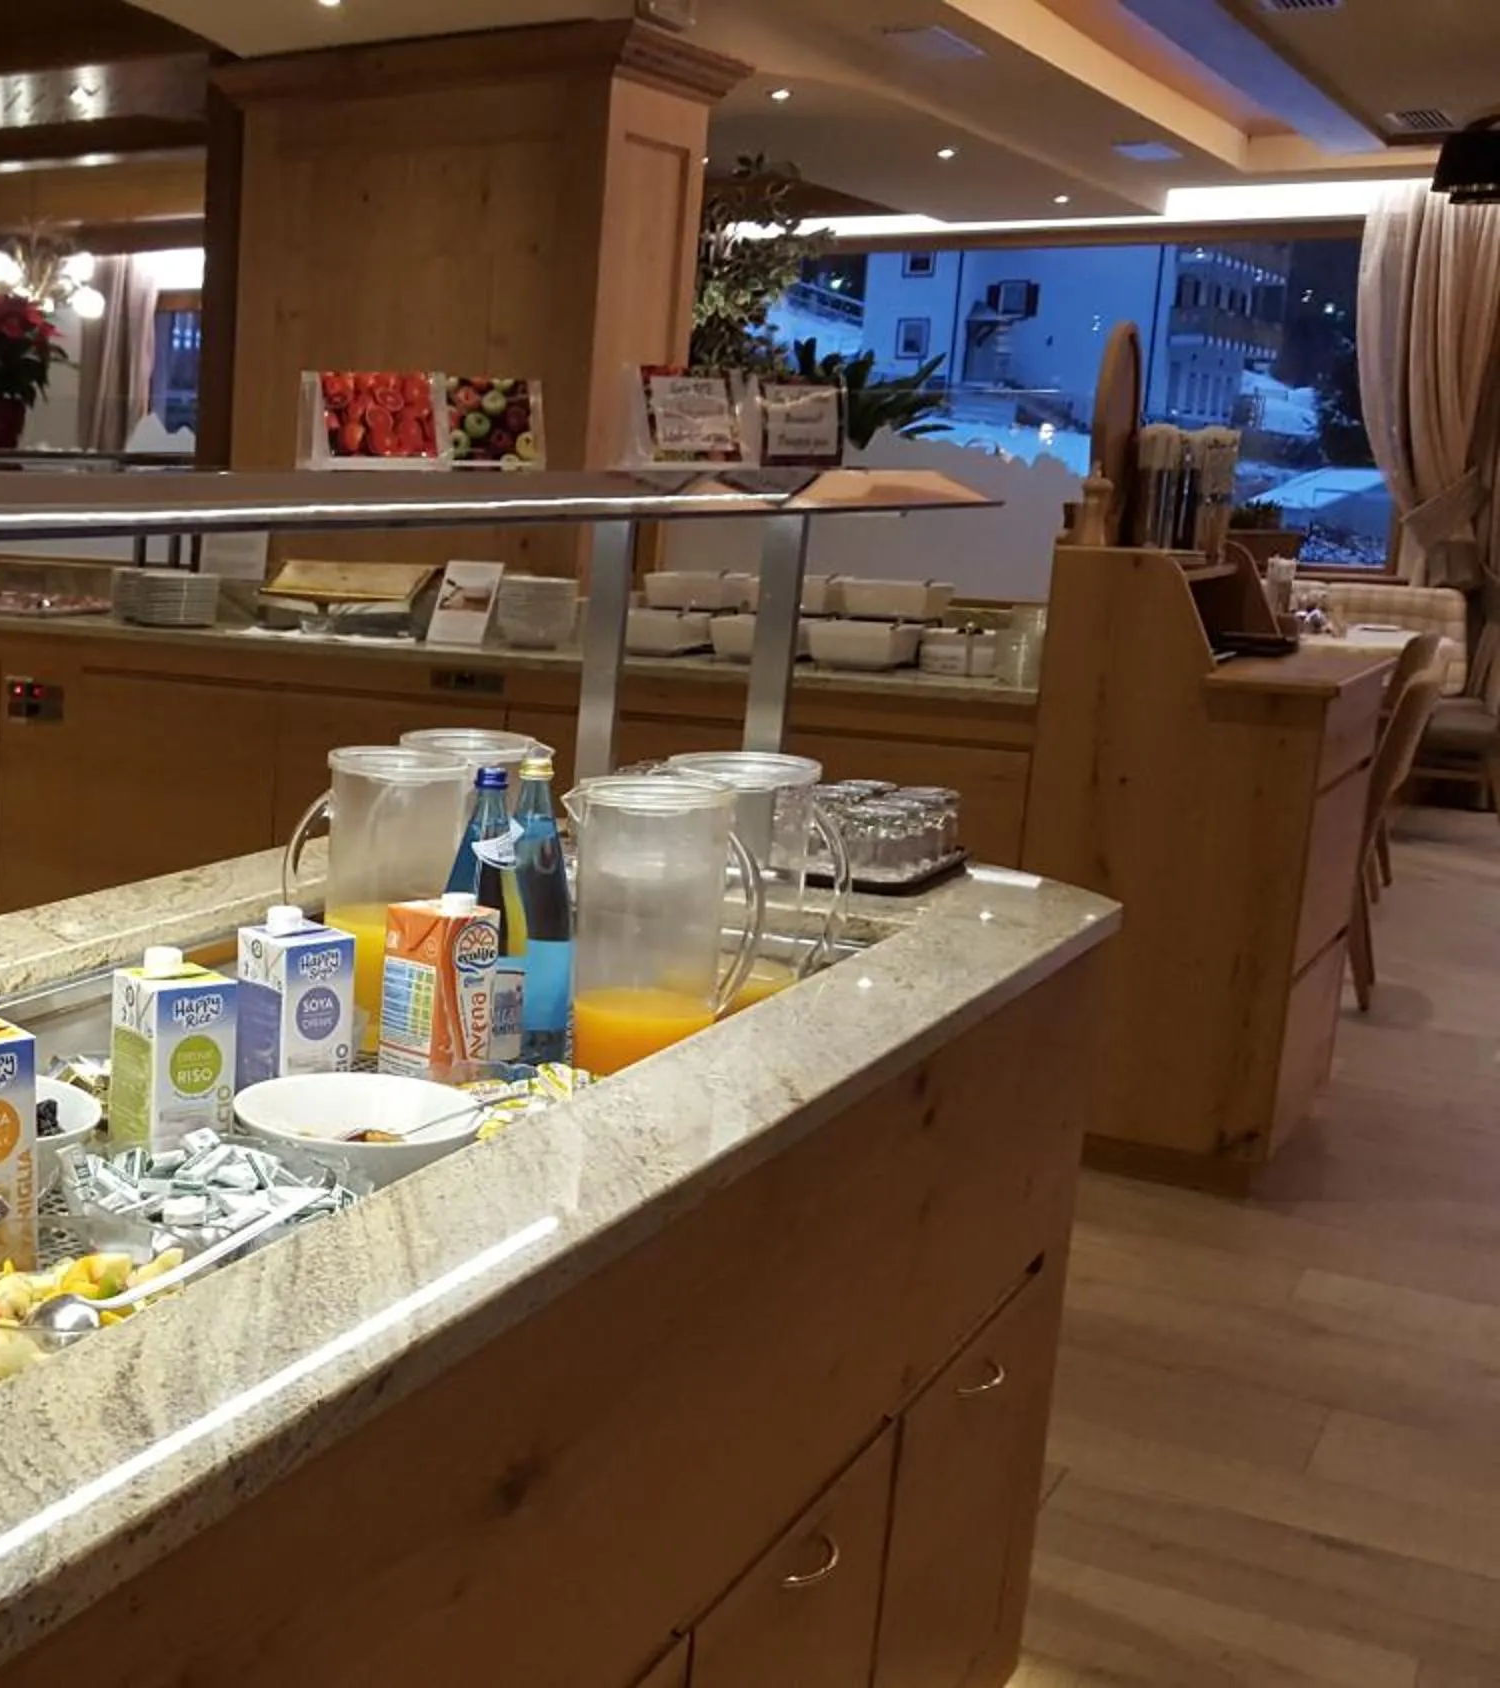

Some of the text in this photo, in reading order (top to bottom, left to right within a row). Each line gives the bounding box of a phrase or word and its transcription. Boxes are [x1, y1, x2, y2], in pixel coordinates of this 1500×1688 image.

[301, 951, 340, 971] Happy
[458, 947, 497, 964] ecolife
[175, 996, 221, 1017] Happy
[302, 998, 333, 1012] SOYA
[186, 1012, 211, 1028] Rice
[468, 992, 488, 1060] Avena
[177, 1067, 213, 1084] RISO
